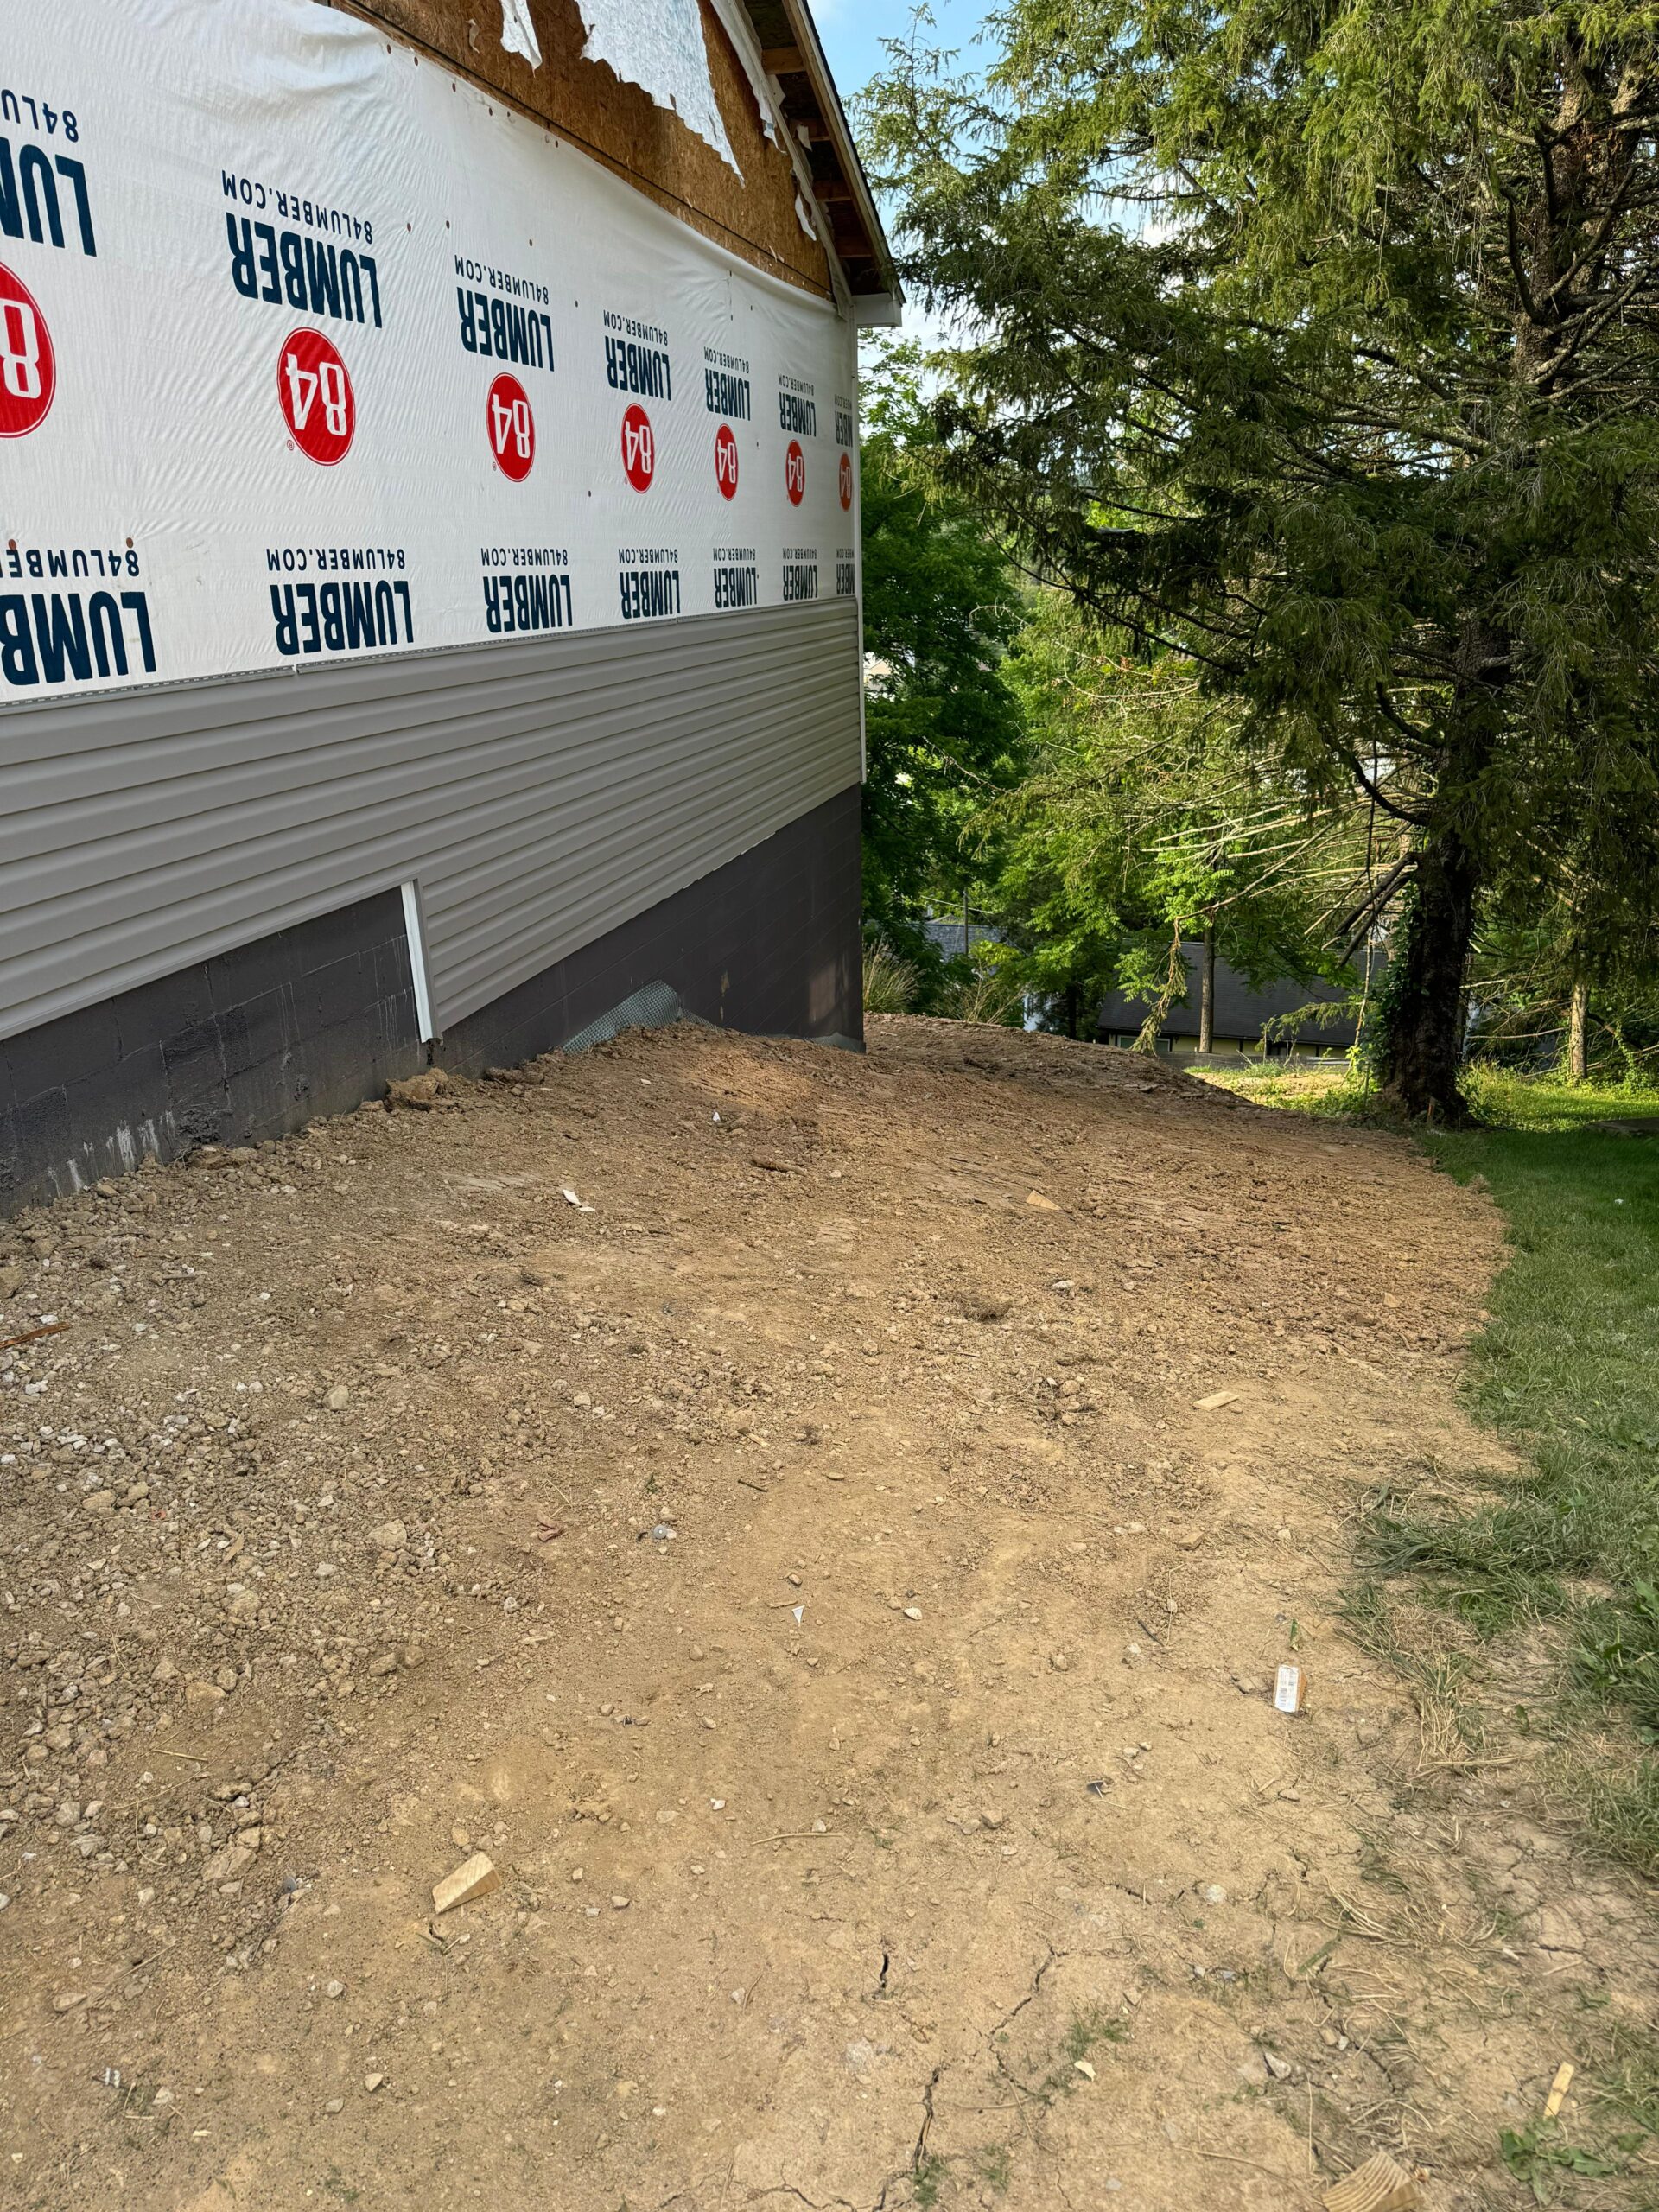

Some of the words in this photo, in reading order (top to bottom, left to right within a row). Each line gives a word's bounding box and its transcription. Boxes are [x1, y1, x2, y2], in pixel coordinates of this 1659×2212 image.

[221, 169, 373, 245] 84LUMBER.COM
[226, 212, 383, 329] LUMBER
[454, 254, 549, 306] 84LUMBER.COM
[456, 286, 555, 372] LUMBER
[603, 309, 669, 346] 84LUMBER.COM
[604, 335, 672, 402] LUMBER
[704, 346, 749, 373] 84LUMBER.COM
[284, 353, 348, 437] 84
[704, 369, 751, 421] LUMBER
[779, 373, 814, 396] 84LUMBER.COM
[492, 393, 531, 460] 84
[779, 391, 817, 437] LUMBER
[625, 420, 652, 474] 84
[717, 439, 736, 484] 84
[787, 454, 804, 493] 84
[0, 548, 140, 578] 84LUMBE
[266, 548, 405, 571] 84LUMBER.COM
[480, 548, 568, 567] 84LUMBER.COM
[618, 548, 678, 564] 84LUMBER.COM
[713, 548, 756, 562] 84LUMBER.COM
[782, 548, 817, 560] 84LUMBER.COM
[482, 574, 573, 633] LUMBER
[619, 569, 681, 620] LUMBER
[714, 567, 757, 608] LUMBER
[783, 564, 818, 601] LUMBER
[269, 579, 414, 656] LUMBER
